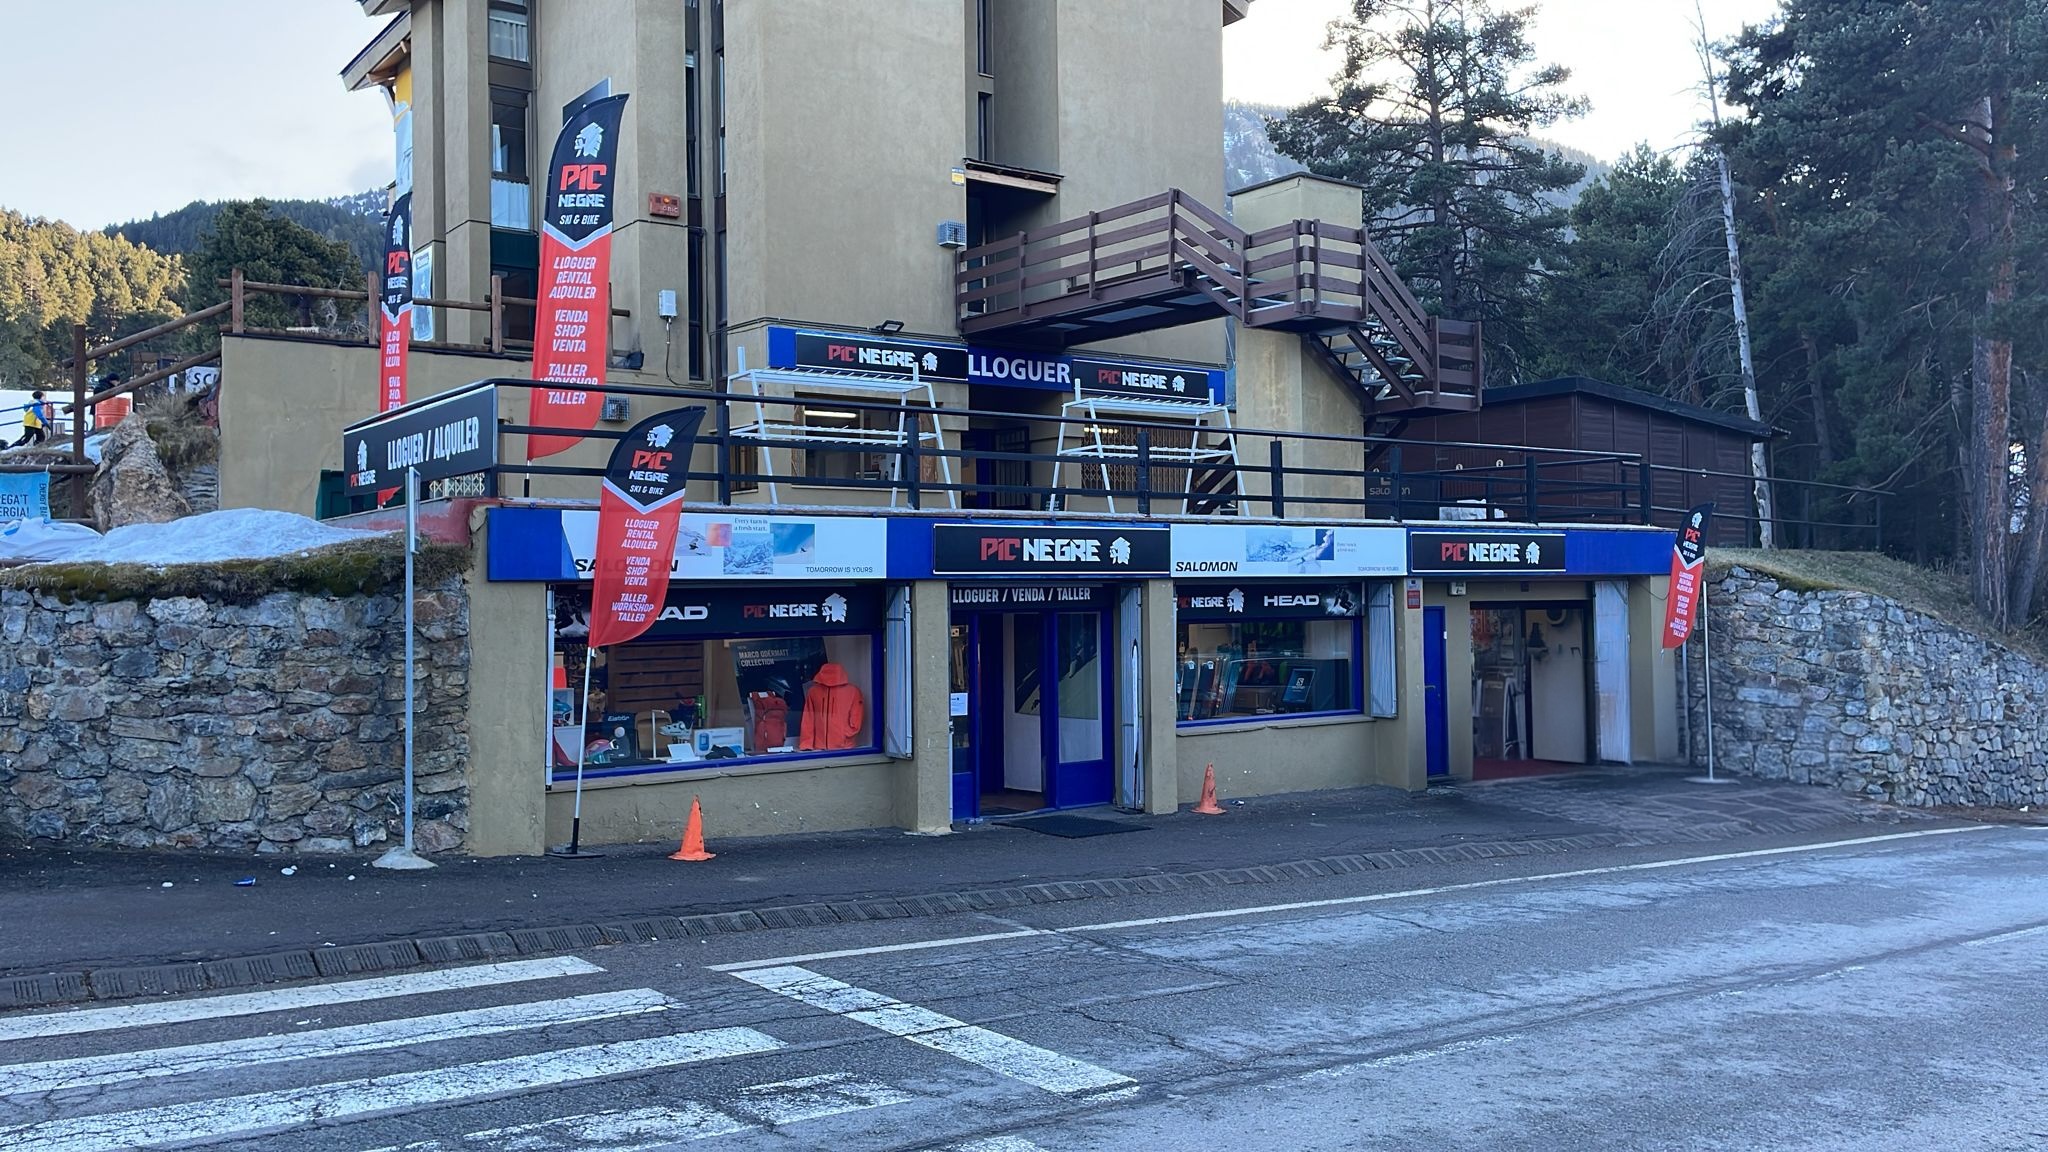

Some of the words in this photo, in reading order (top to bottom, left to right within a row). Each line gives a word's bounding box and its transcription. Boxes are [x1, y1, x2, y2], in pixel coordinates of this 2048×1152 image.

[558, 194, 605, 208] NEGRE
[559, 214, 571, 225] SKI
[573, 214, 580, 225] &
[581, 214, 600, 225] BIKE
[553, 256, 596, 270] LLOGUER
[556, 271, 592, 285] RENTAL
[549, 285, 596, 300] ALQUILER
[555, 309, 588, 323] VENDA
[554, 324, 586, 338] SHOP
[552, 339, 586, 353] VENTA
[858, 347, 916, 368] NEGRE
[548, 363, 588, 377] TALLER
[968, 354, 1071, 384] LLOGUER
[1122, 371, 1168, 390] NEGRE
[548, 391, 587, 405] TALLER
[387, 432, 424, 471] LLOGUER
[425, 430, 432, 461] /
[433, 416, 480, 461] ALQUILER
[628, 470, 670, 483] NEGRE
[629, 484, 640, 494] SKI
[642, 486, 648, 494] &
[649, 486, 665, 496] BIKE
[0, 494, 28, 505] EGA'T
[624, 518, 659, 530] LLOGUER
[626, 529, 654, 540] RENTAL
[621, 539, 658, 550] ALQUILER
[1023, 538, 1101, 562] NEGRE
[1468, 542, 1520, 562] NEGRE
[625, 556, 651, 566] VENDA
[1175, 561, 1238, 572] SALOMON
[625, 566, 649, 576] SHOP
[624, 576, 648, 586] VENTA
[620, 593, 648, 603] TALLER
[953, 588, 999, 603] LLOGUER
[1002, 588, 1008, 602] /
[1012, 588, 1045, 602] VENDA
[1048, 587, 1054, 601] /
[1057, 587, 1091, 600] TALLER
[1264, 595, 1320, 607] HEAD
[611, 602, 654, 612] WORKSHOP
[1191, 596, 1225, 608] NEGRE
[618, 612, 646, 622] TALLER
[769, 603, 818, 618] NEGRE
[738, 650, 760, 659] MARCO
[760, 648, 789, 658] ODERMATT
[740, 658, 775, 667] COLLECTION
